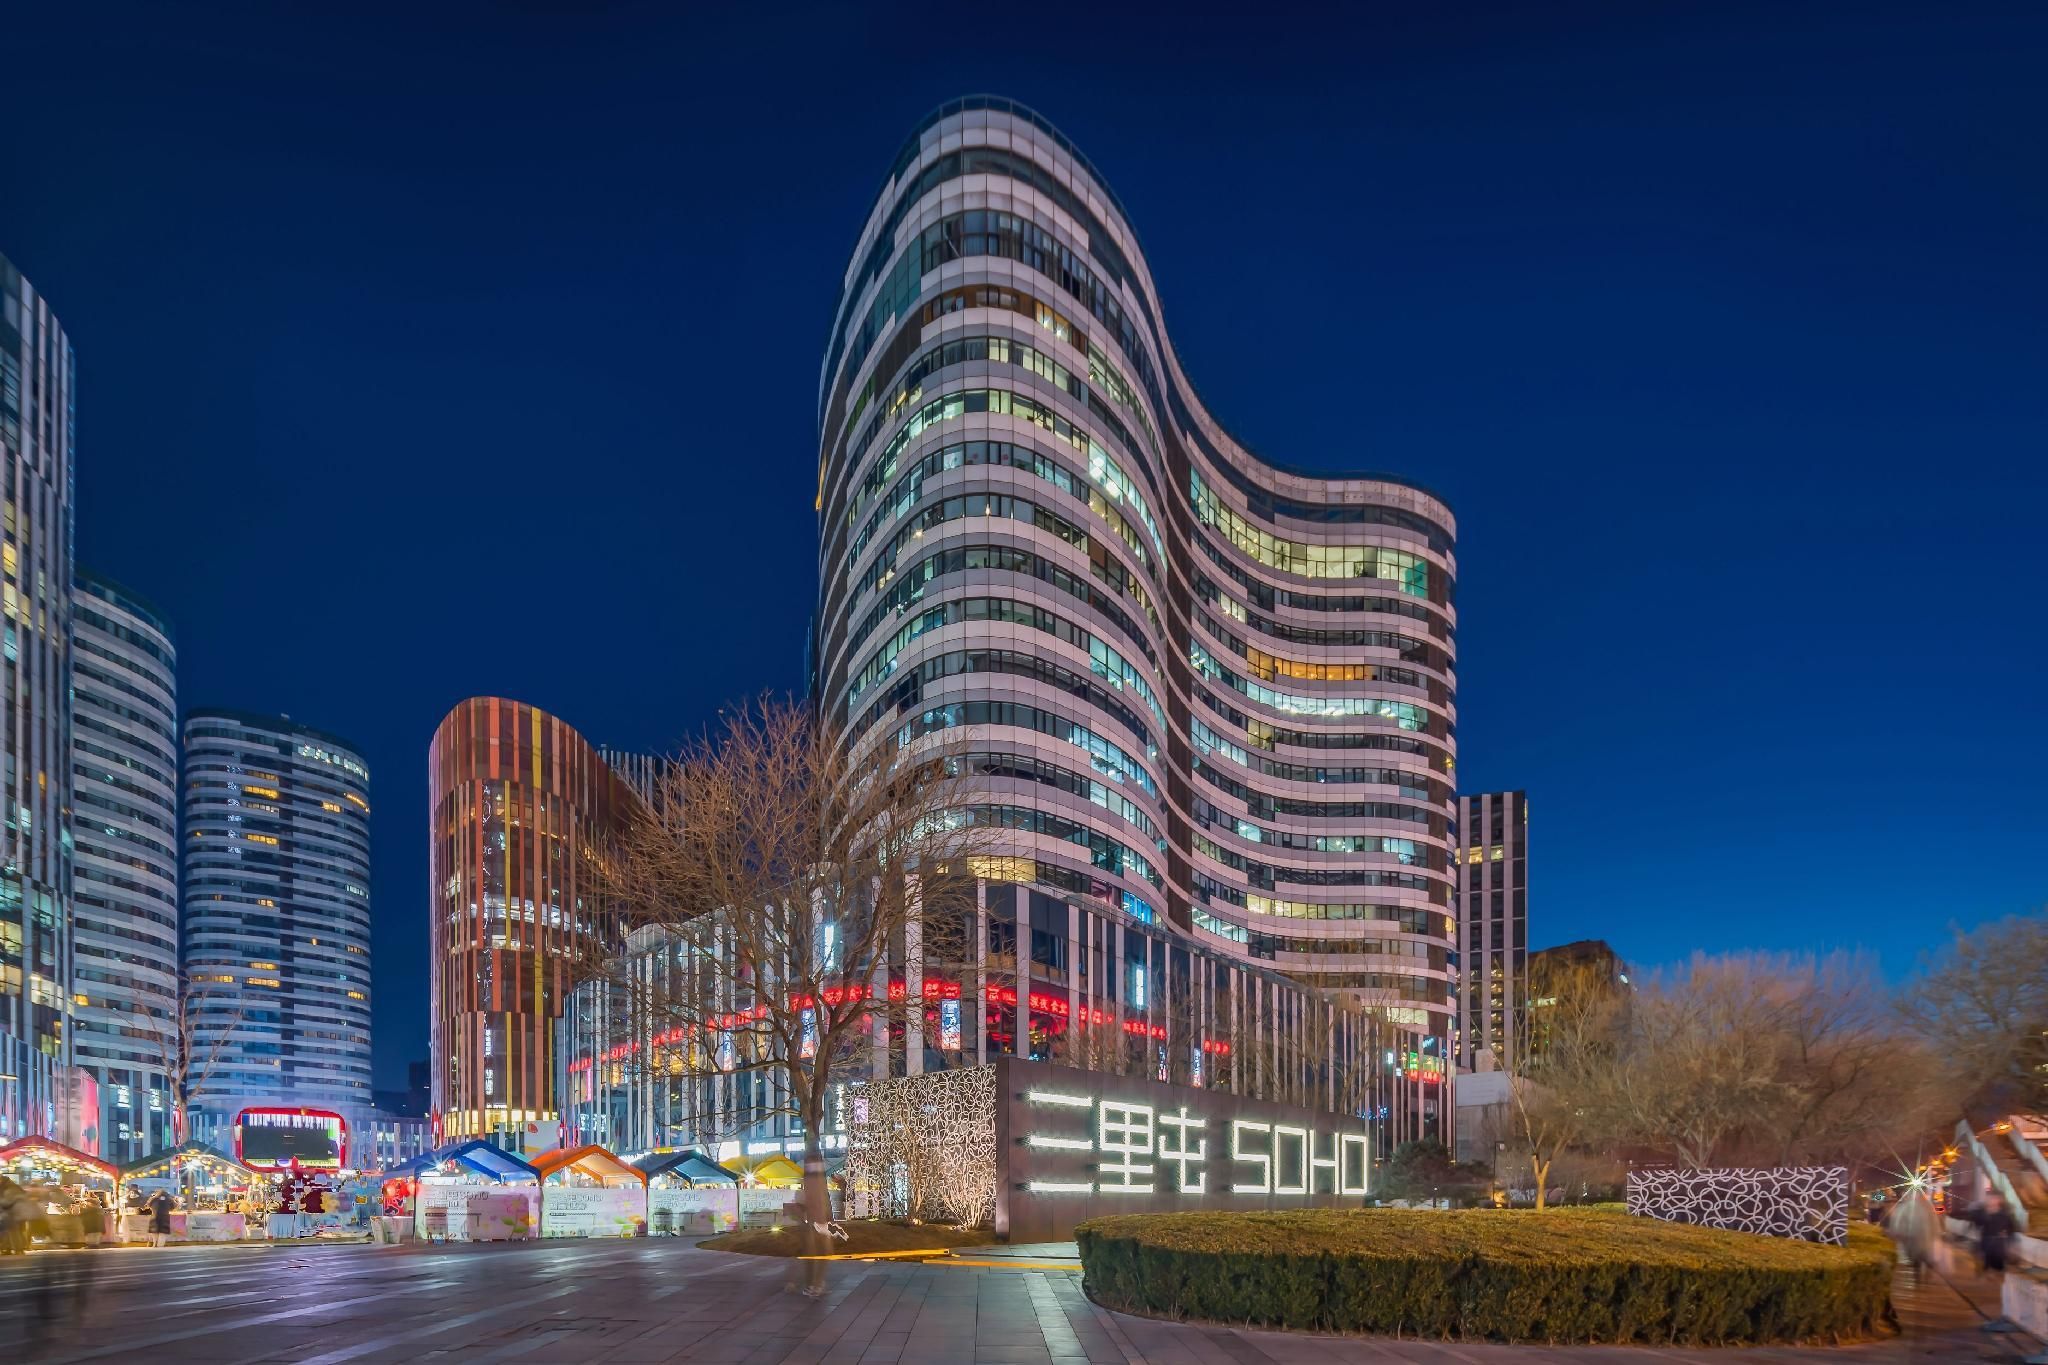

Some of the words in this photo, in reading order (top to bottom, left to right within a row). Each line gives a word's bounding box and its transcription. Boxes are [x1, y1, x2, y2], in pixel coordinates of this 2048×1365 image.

[1028, 1091, 1206, 1194] 三里屯
[1233, 1119, 1367, 1195] SOHO
